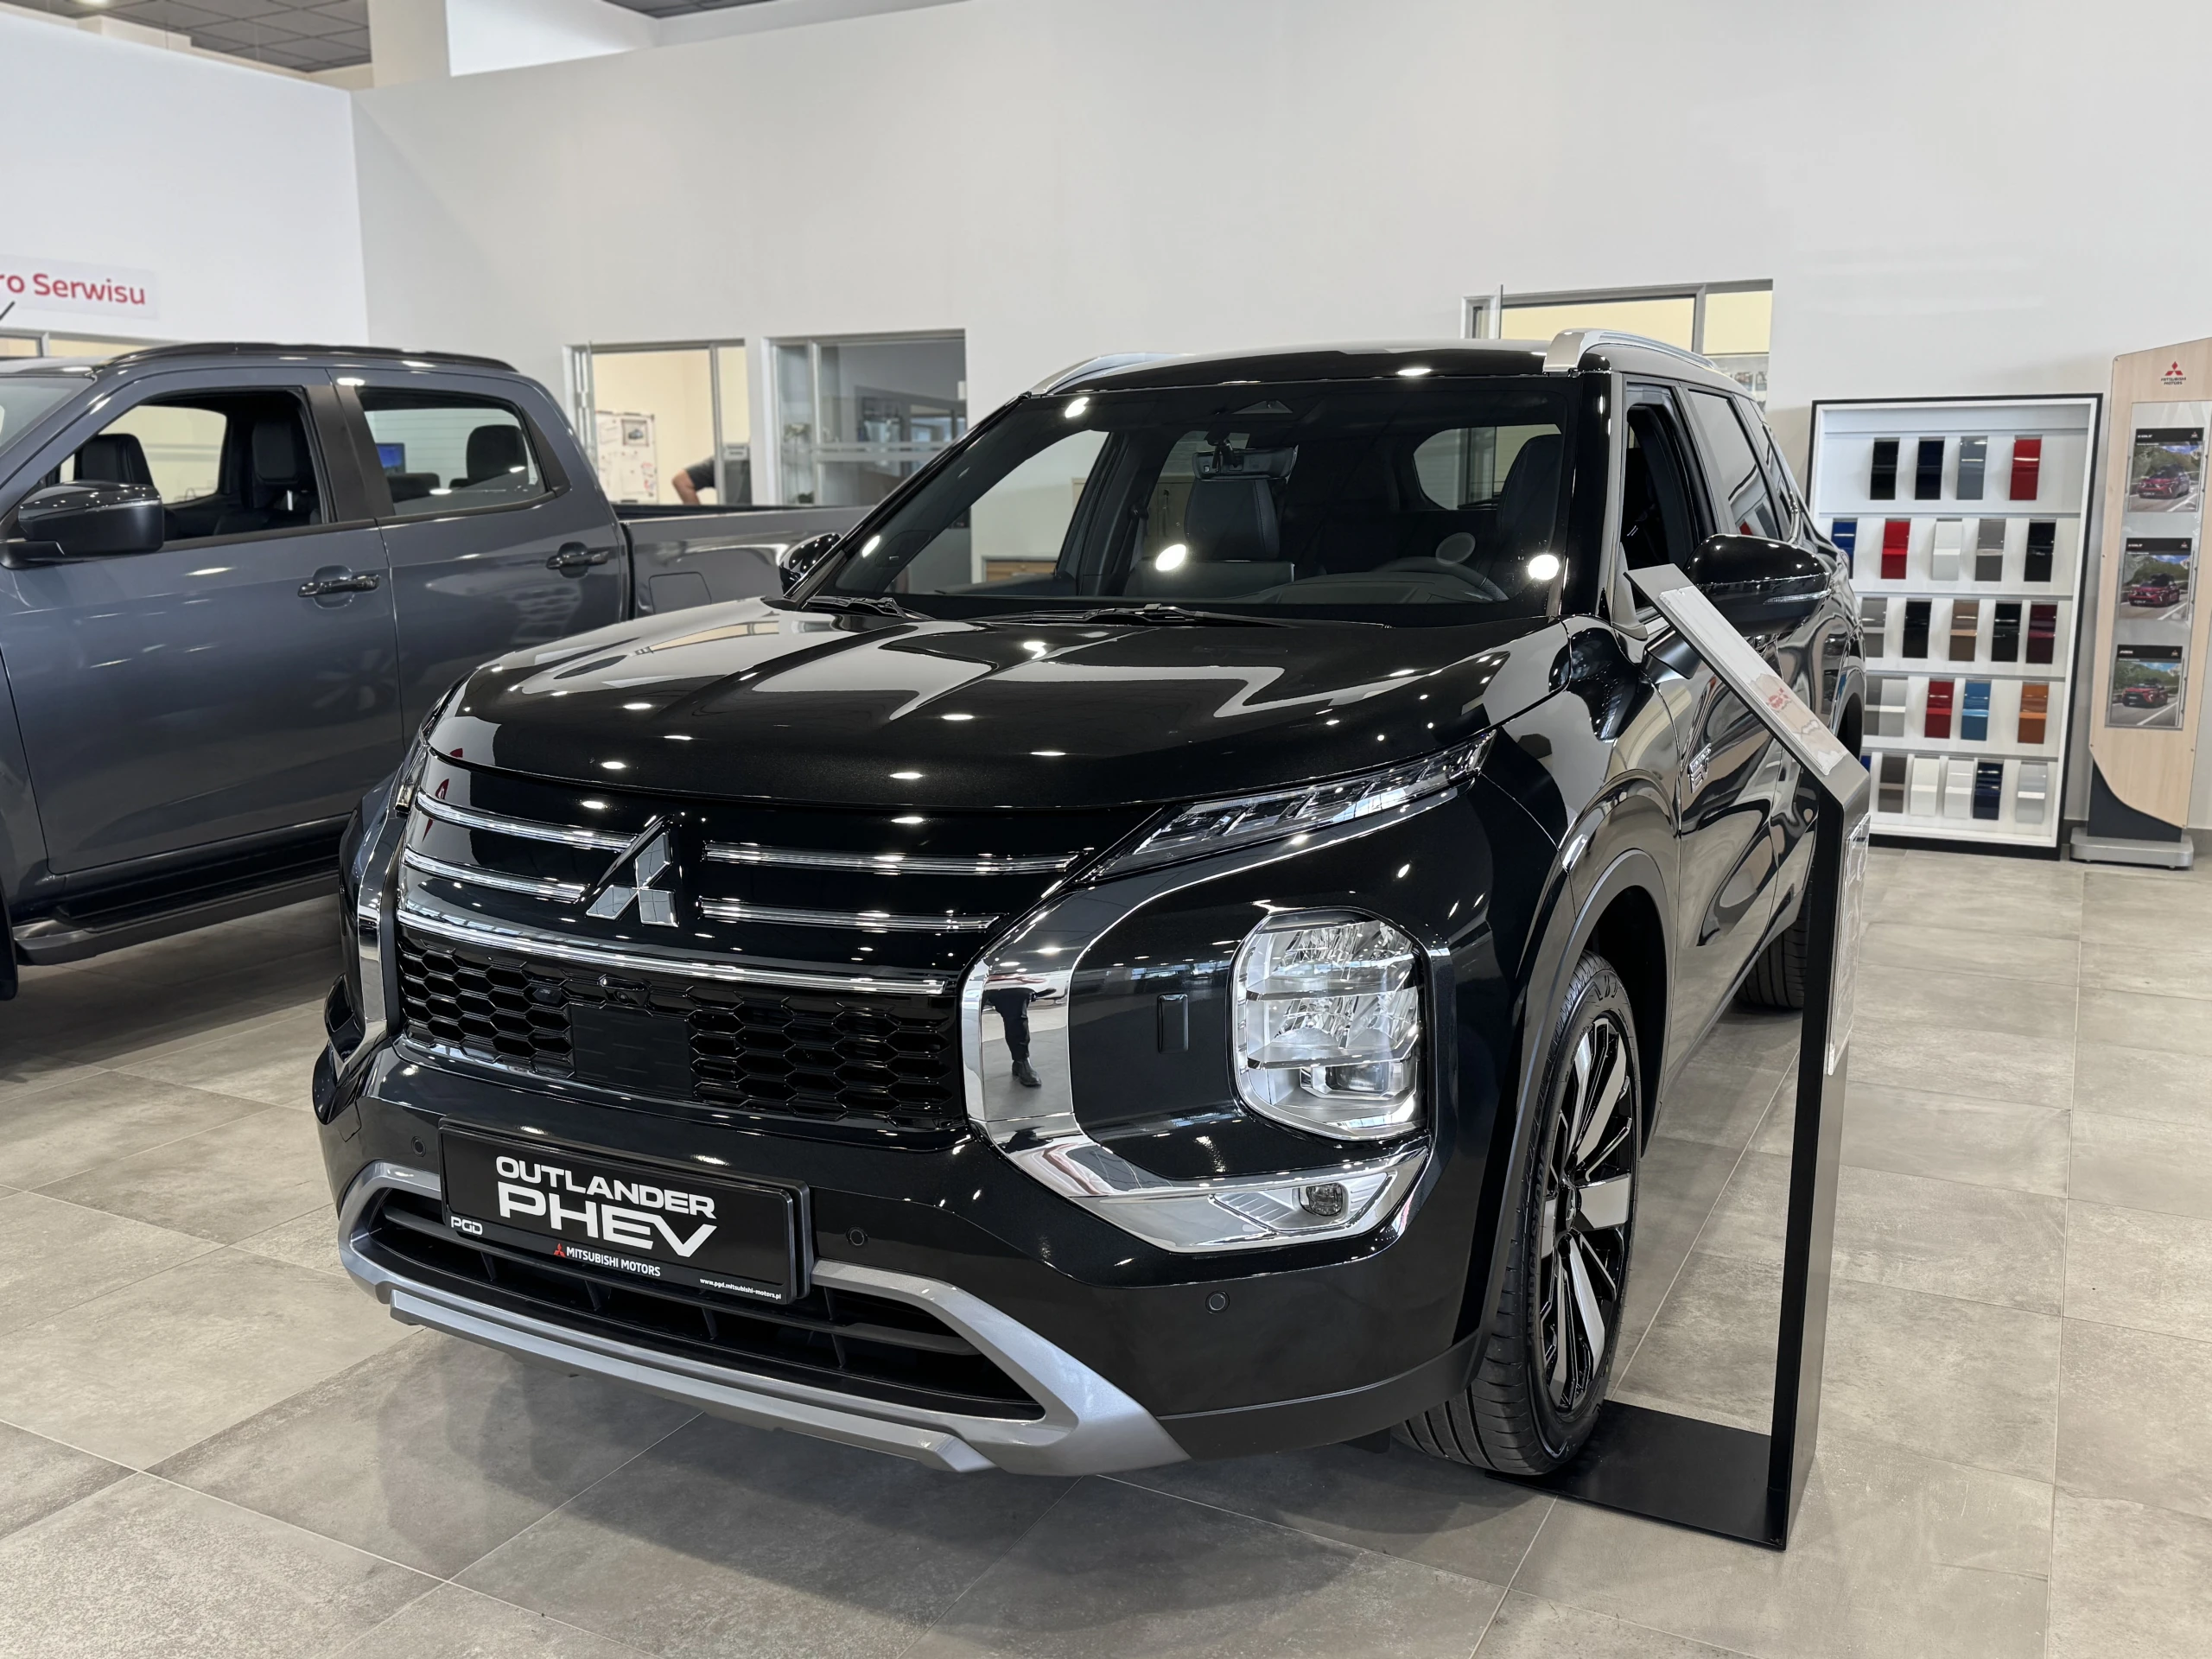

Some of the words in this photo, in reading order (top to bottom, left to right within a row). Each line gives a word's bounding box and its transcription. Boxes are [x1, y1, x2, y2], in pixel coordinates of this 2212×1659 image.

[33, 273, 145, 305] Serwisu
[496, 1156, 717, 1219] OUTLANDER
[451, 1216, 483, 1236] PGD
[497, 1181, 717, 1257] PHEV
[566, 1246, 619, 1268] MITSUBISHI
[620, 1259, 661, 1277] MOTORS
[699, 1279, 782, 1300] www.pgd.mitsubishi-motors.pl
